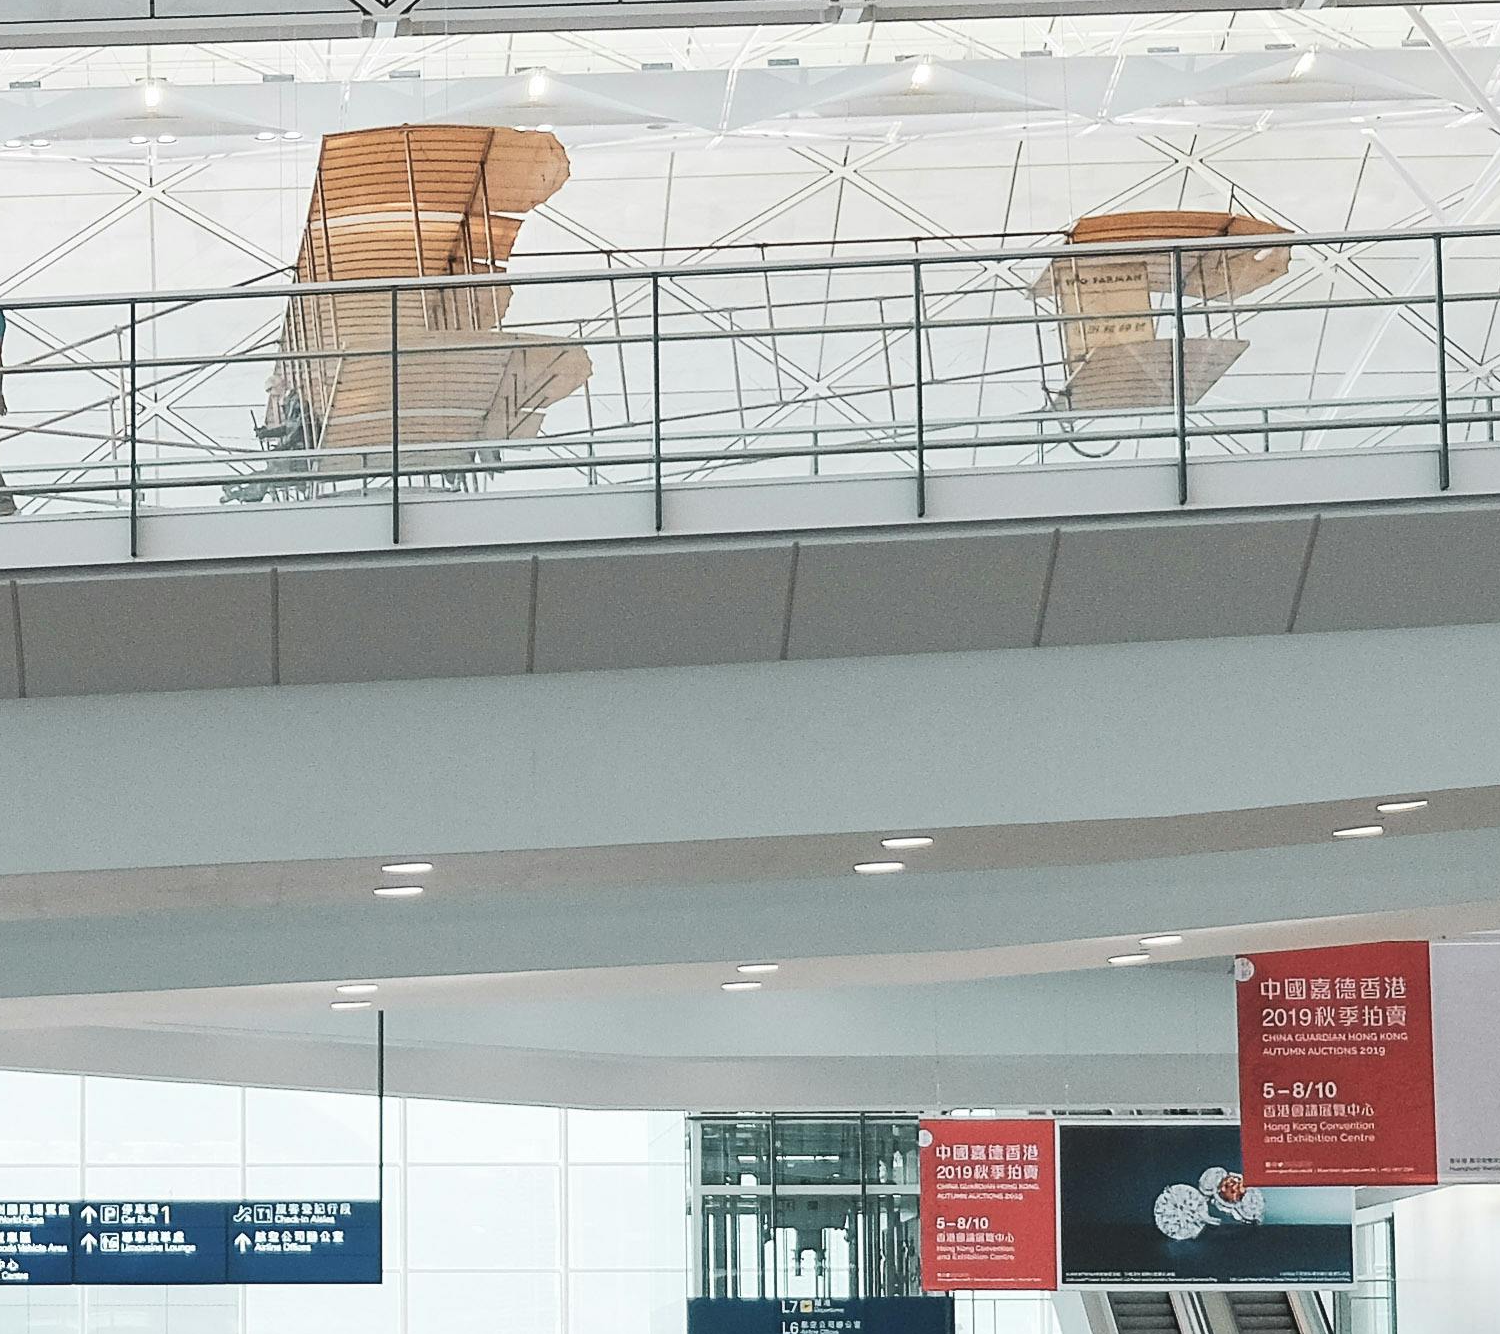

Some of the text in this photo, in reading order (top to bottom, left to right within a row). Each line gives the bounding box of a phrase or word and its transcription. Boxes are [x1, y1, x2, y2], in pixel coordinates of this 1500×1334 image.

[1260, 976, 1407, 1000] 中國嘉德香港
[1262, 1032, 1408, 1042] CHINA GUARDIAN HONG KONG
[1262, 1046, 1386, 1056] AUTUMN AUCTIONS 2019
[1263, 1121, 1375, 1132] Hong Kong Convention
[1263, 1132, 1376, 1143] and Exhibition Centre
[781, 1299, 799, 1314] L7
[781, 1321, 799, 1334] L6
